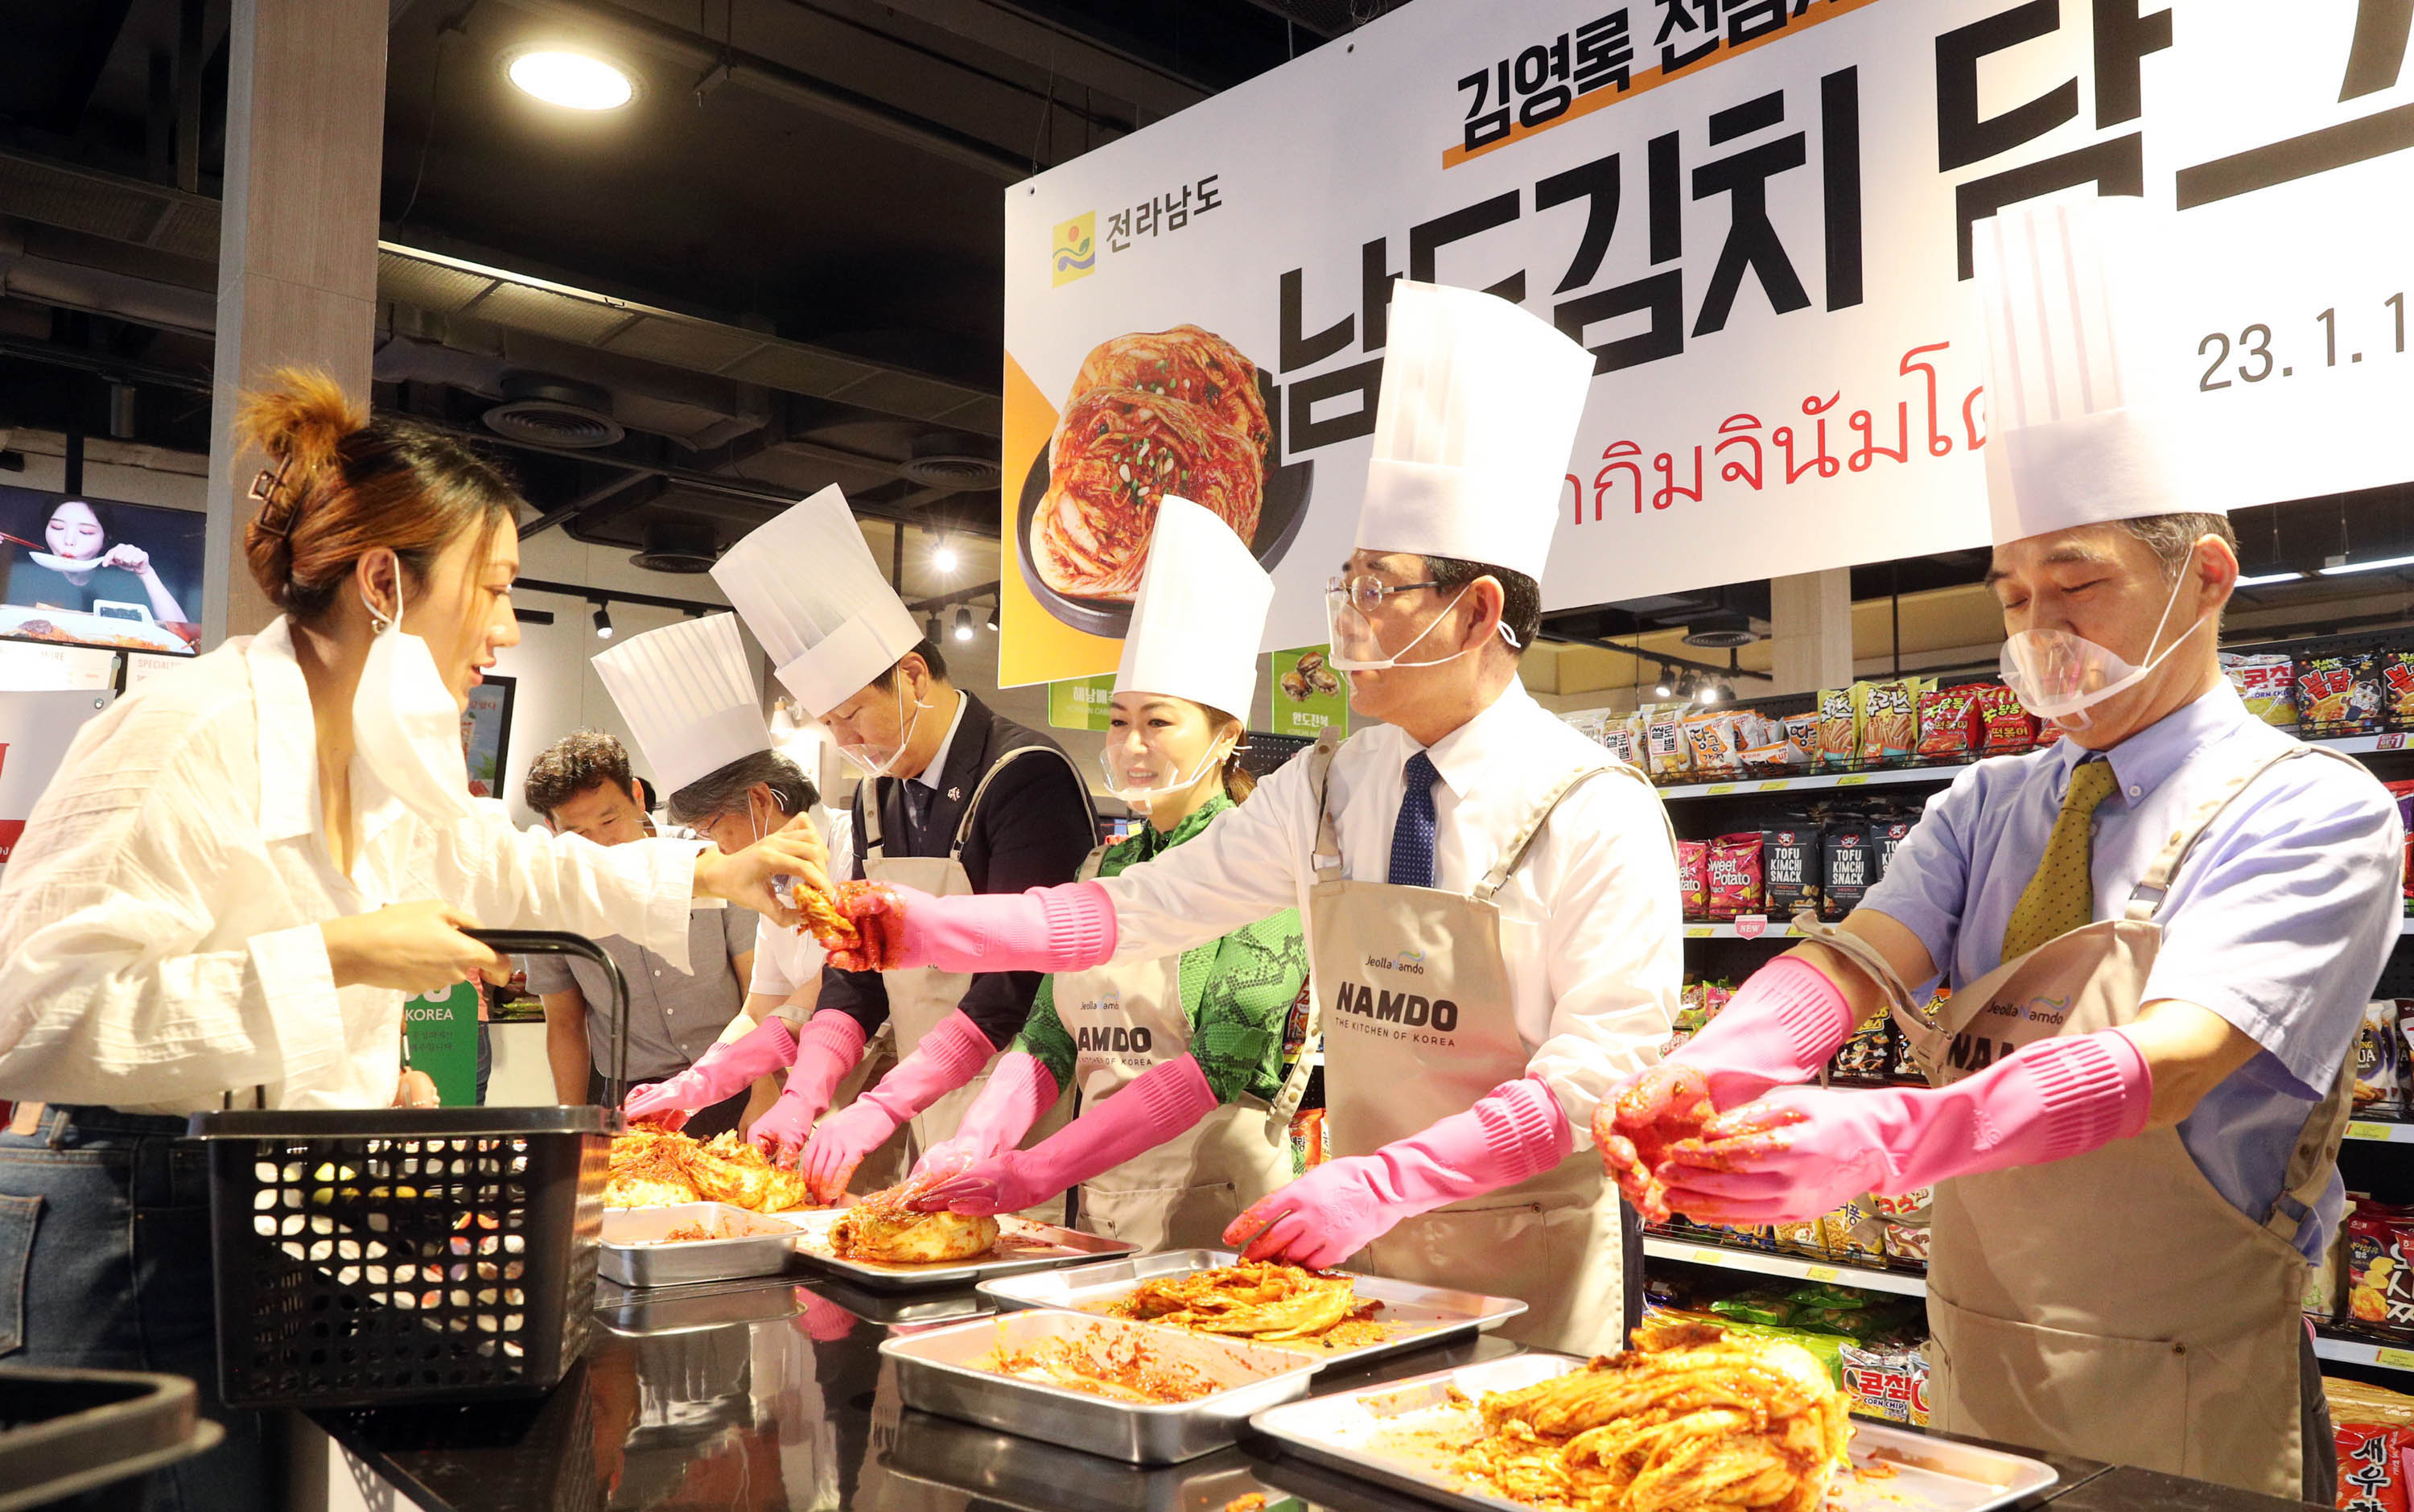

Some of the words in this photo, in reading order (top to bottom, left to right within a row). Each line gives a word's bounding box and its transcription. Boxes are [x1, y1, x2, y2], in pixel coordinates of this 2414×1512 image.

[1457, 7, 1634, 152] 김영록
[1106, 174, 1222, 253] 전라남도
[1992, 726, 2029, 739] 떡볶이
[1775, 848, 1800, 859] TOFU
[1836, 850, 1862, 861] TOFU
[1770, 859, 1802, 871] KIMCHI
[1832, 861, 1864, 873] KIMCHI
[1713, 871, 1751, 886] Potato
[1770, 871, 1802, 883] SNACK
[1832, 873, 1864, 885] SNACK
[1740, 925, 1761, 933] NEW
[1336, 981, 1458, 1032] NAMDO
[405, 1008, 454, 1021] KOREA
[1335, 1017, 1349, 1028] THE
[1352, 1021, 1389, 1037] KITCHEN
[1393, 1031, 1407, 1040] OF
[1413, 1034, 1456, 1047] KOREA
[1077, 1027, 1152, 1053] AMDO
[1105, 1057, 1117, 1066] OF
[1122, 1057, 1152, 1066] KOREA
[1859, 1370, 1911, 1401] 콘칩
[1864, 1397, 1883, 1407] CORN
